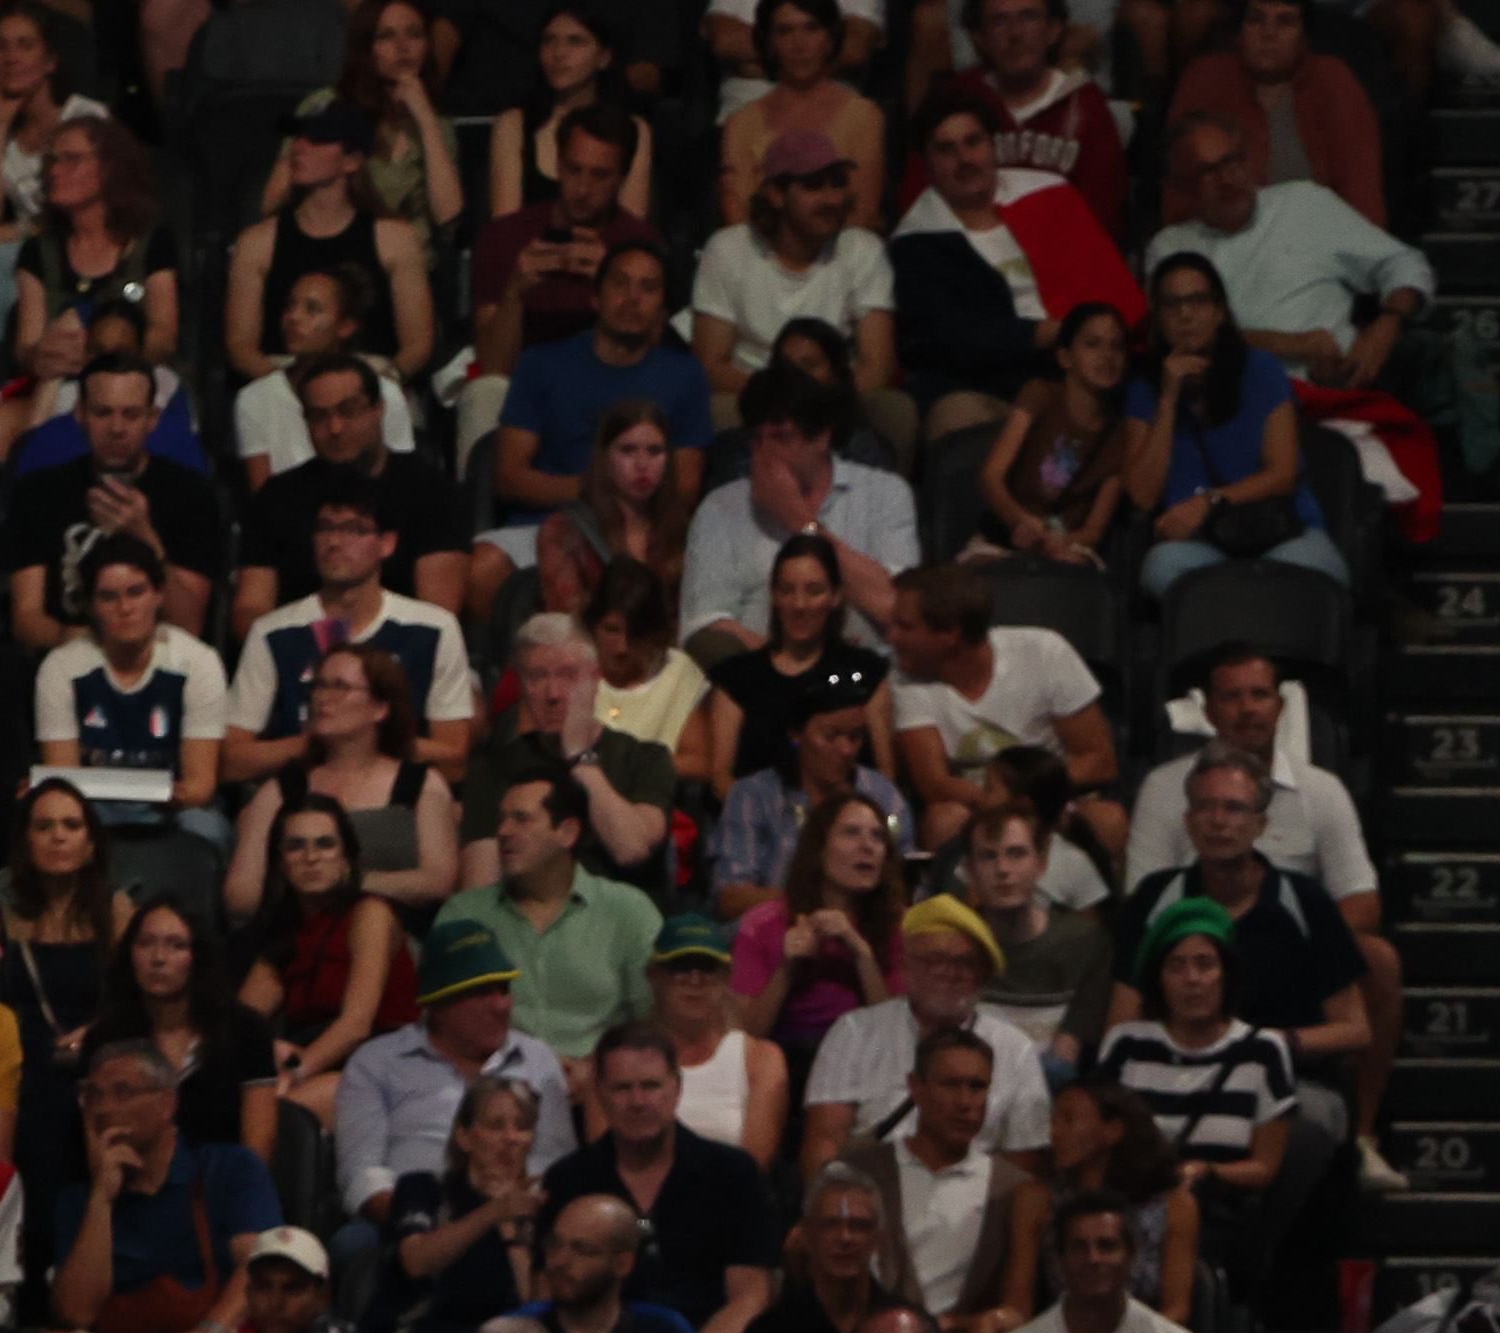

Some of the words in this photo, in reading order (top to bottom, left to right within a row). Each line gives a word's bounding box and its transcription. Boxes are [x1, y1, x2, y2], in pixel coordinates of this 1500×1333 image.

[1438, 585, 1485, 617] 24
[1432, 728, 1480, 760] 23
[1431, 867, 1480, 899] 22
[1427, 1001, 1468, 1033] 21
[1417, 1136, 1470, 1170] 20
